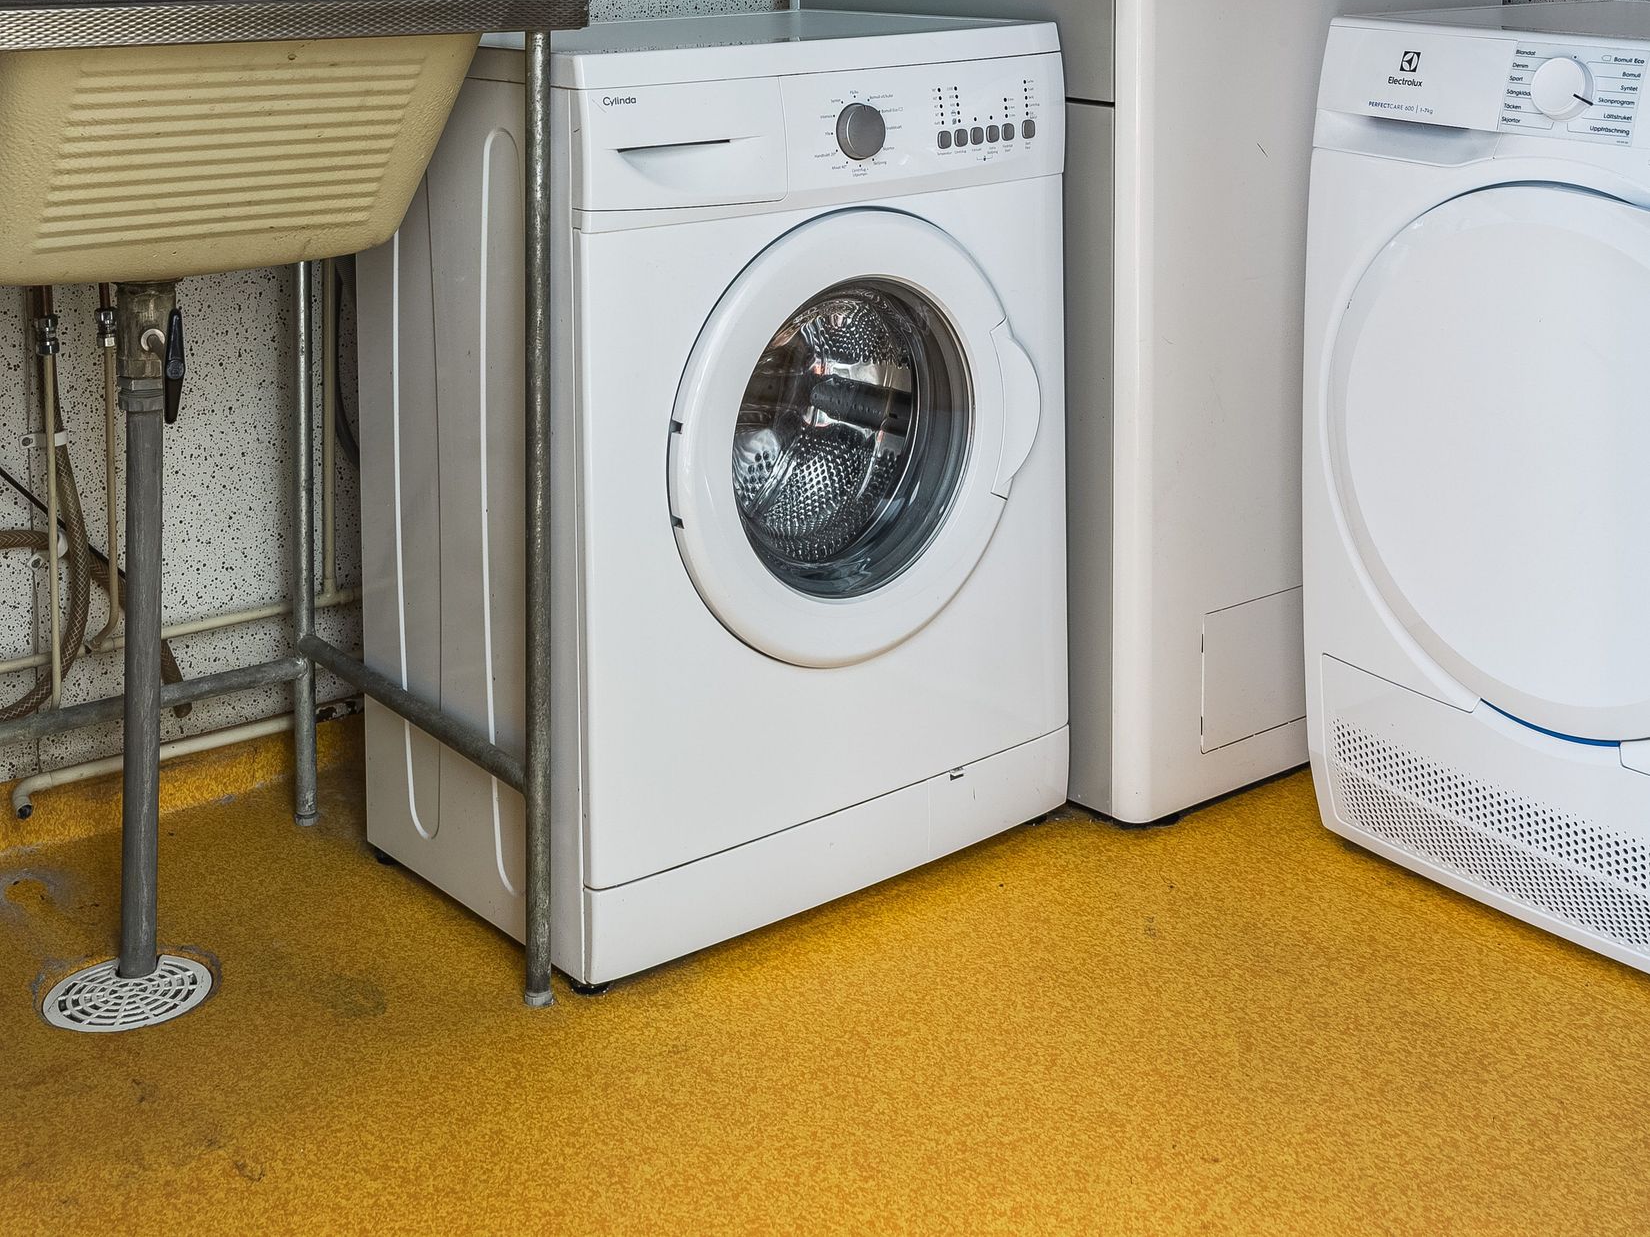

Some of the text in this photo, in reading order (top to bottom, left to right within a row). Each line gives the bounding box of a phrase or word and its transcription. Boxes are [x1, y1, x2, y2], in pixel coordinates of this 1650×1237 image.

[1388, 76, 1423, 87] Electrolux
[1620, 84, 1638, 92] Syntet
[1506, 88, 1532, 97] Sängkläd
[602, 96, 637, 107] Cylinda
[1598, 97, 1635, 106] Skonprogram
[1504, 102, 1522, 110] Täcken
[1501, 115, 1521, 123] Skjortor
[1603, 113, 1633, 121] Lättstruket
